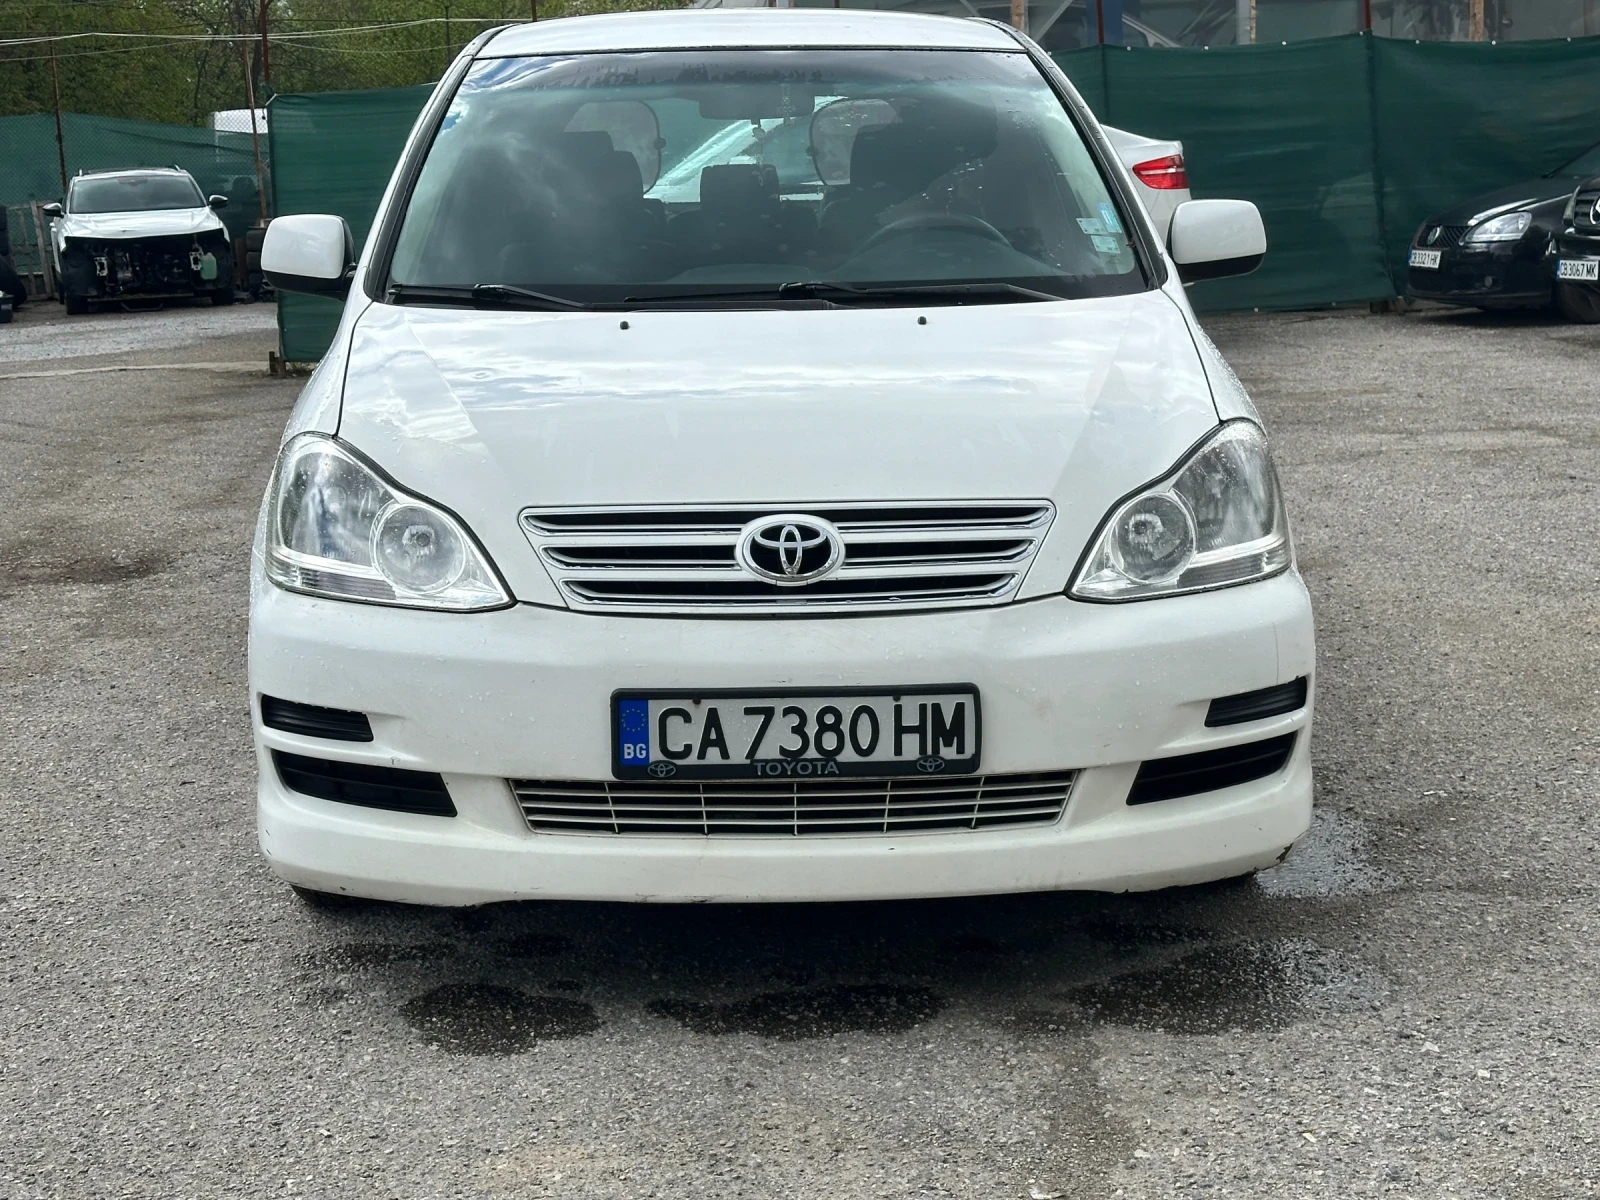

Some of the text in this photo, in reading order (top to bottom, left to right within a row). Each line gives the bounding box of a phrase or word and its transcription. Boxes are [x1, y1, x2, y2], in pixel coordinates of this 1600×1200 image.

[1560, 262, 1596, 278] CB 3067 MK
[658, 702, 965, 760] CA 7380 HM
[624, 743, 647, 759] BG
[754, 761, 839, 776] TOYOTA
